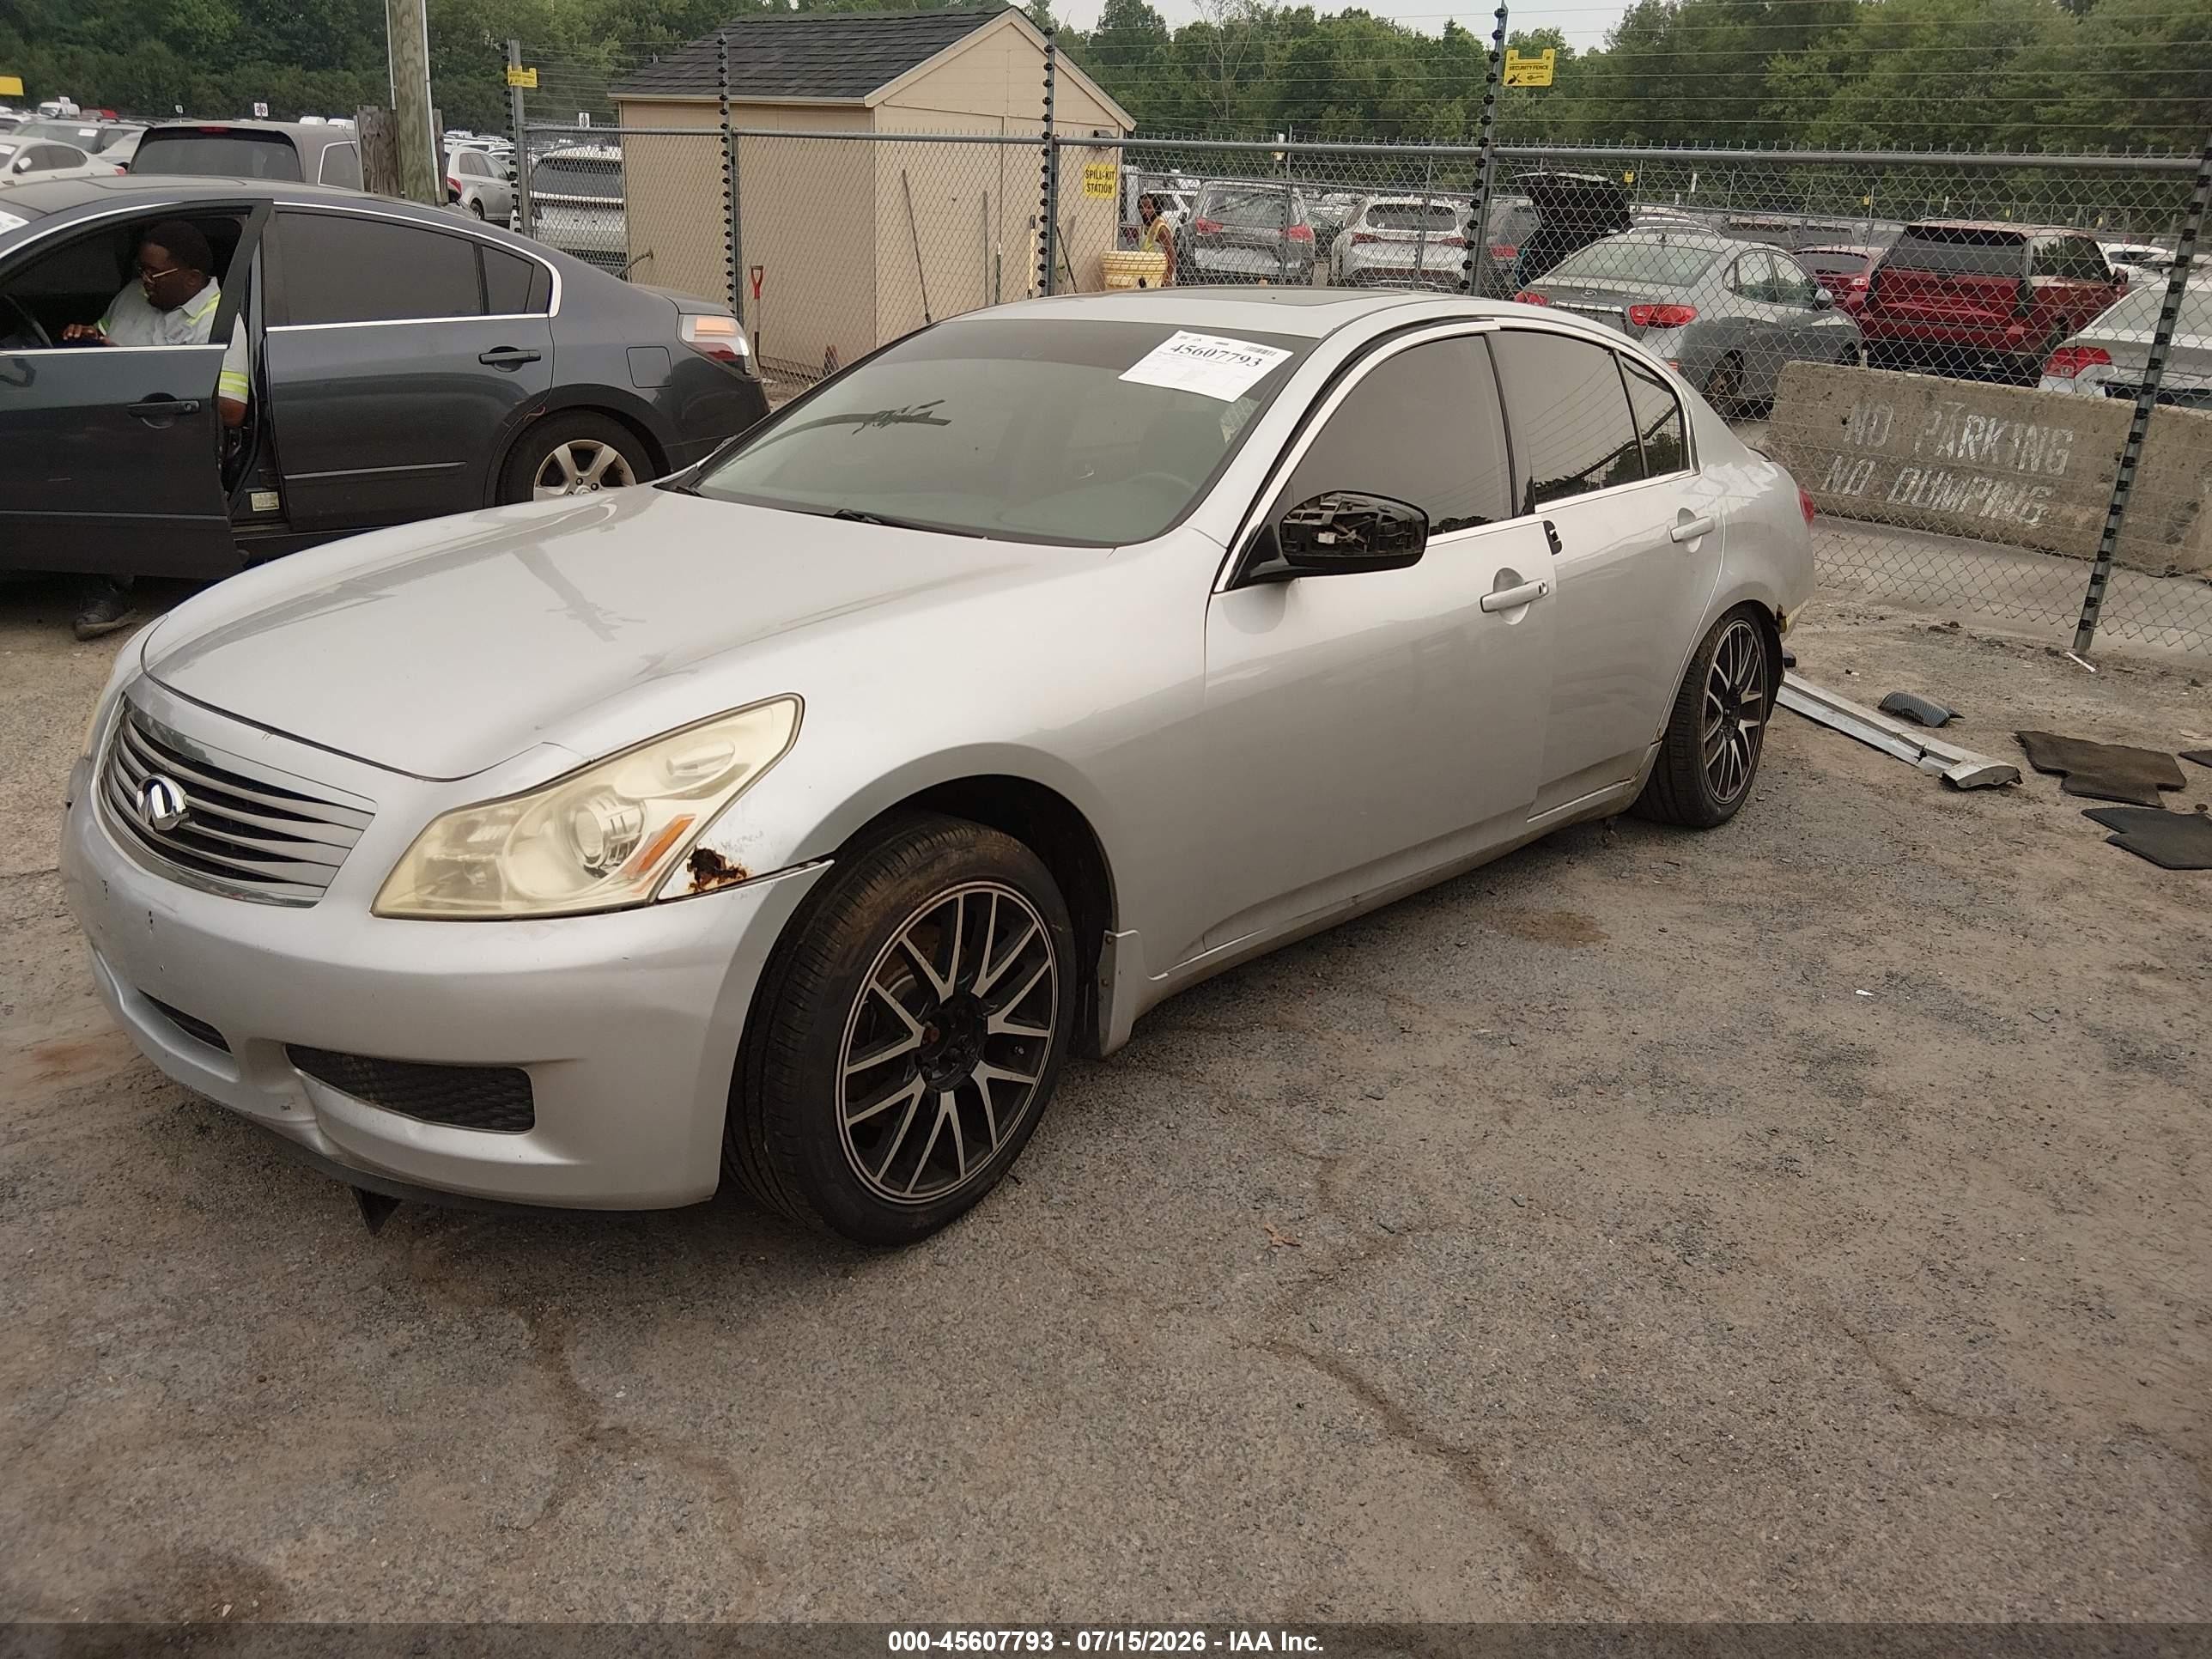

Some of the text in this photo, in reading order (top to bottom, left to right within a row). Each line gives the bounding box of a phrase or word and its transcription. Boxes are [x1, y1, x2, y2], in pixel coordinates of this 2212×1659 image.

[1086, 183, 1113, 194] STATION
[1170, 343, 1263, 368] 45607793
[1844, 403, 1894, 447] NO
[1820, 455, 1877, 496] NO
